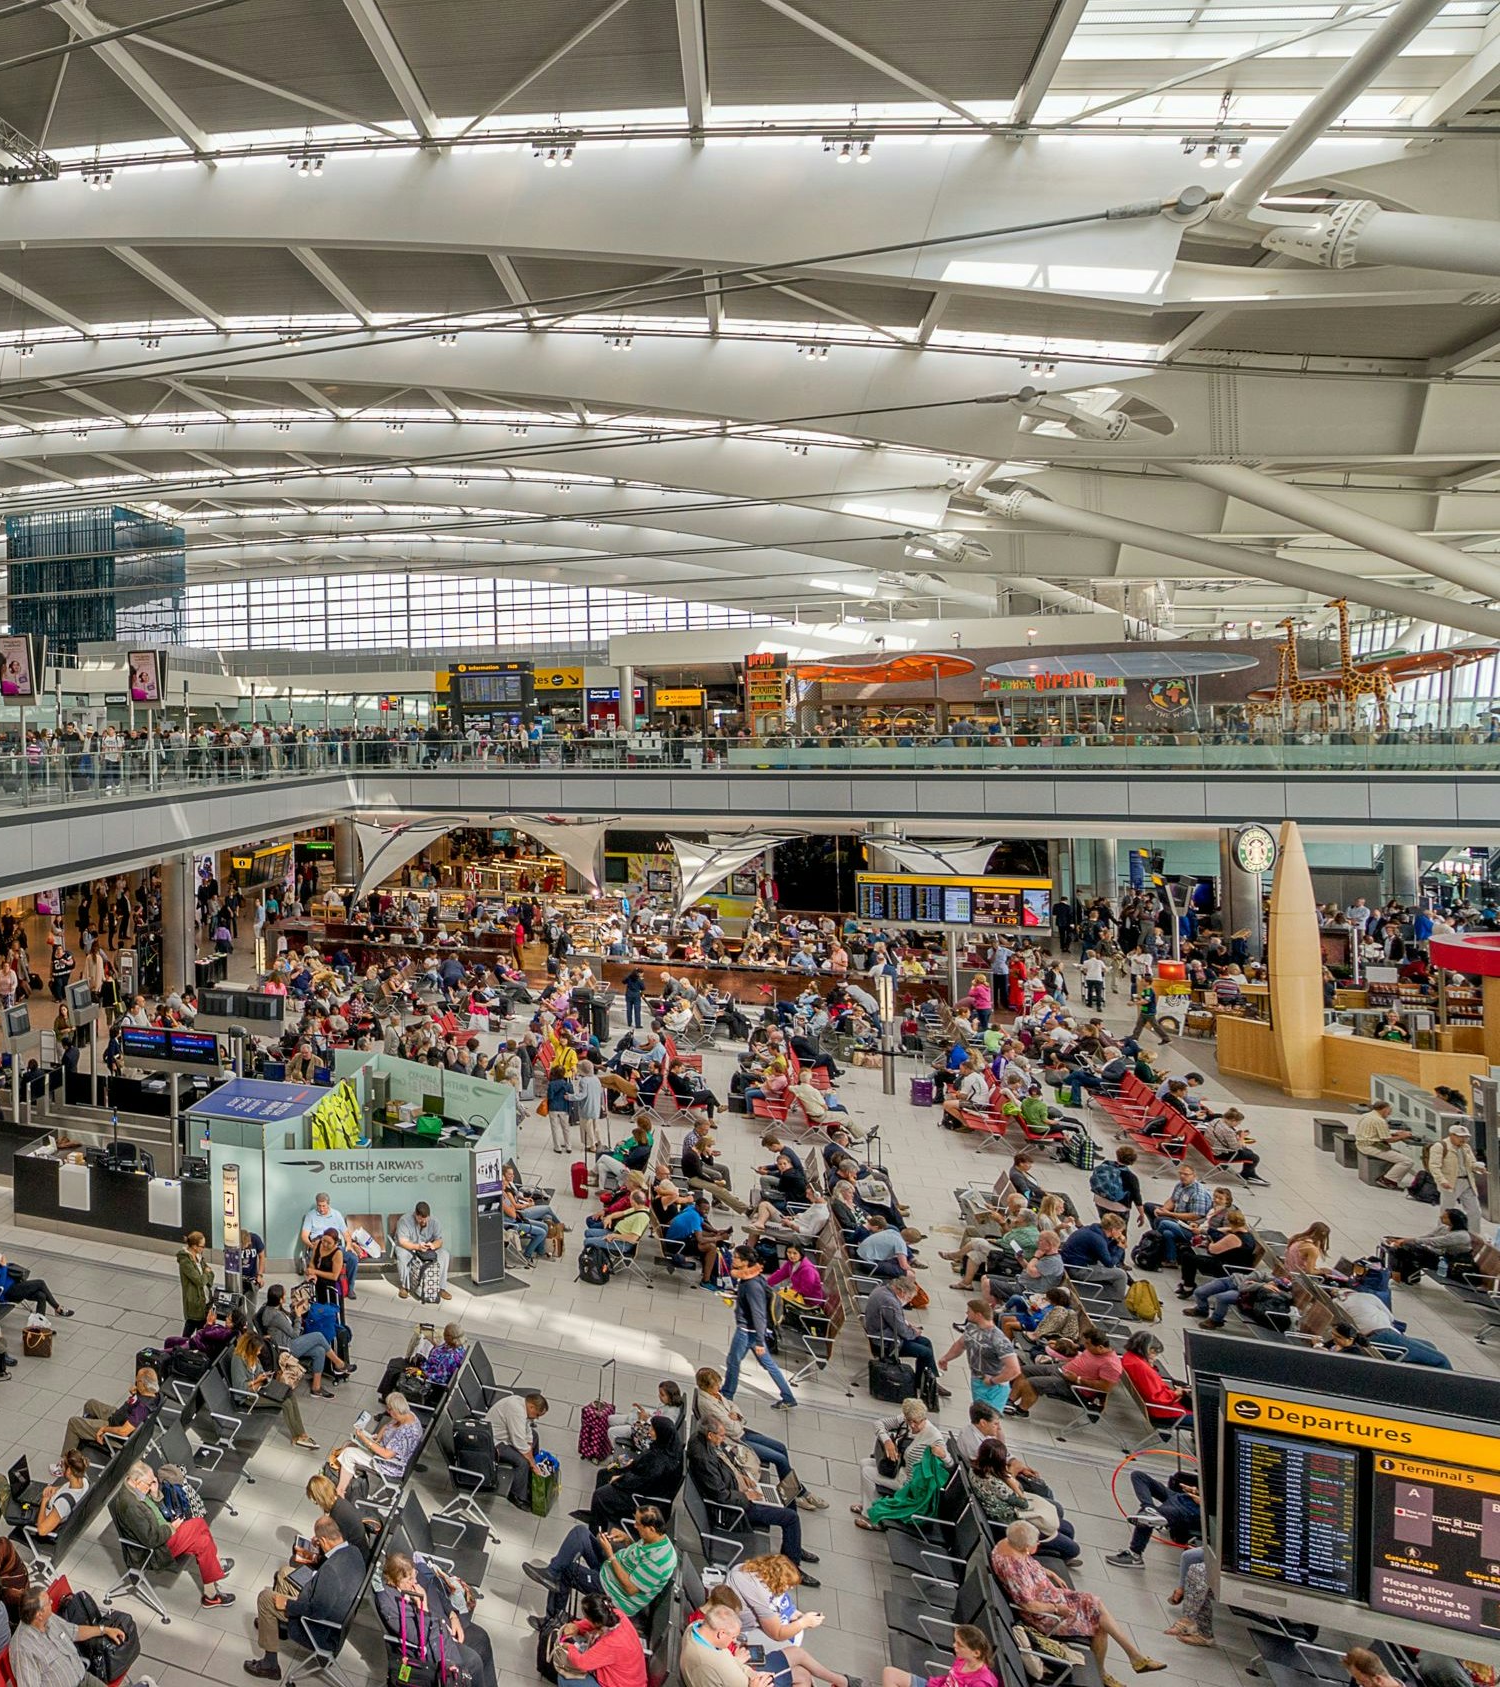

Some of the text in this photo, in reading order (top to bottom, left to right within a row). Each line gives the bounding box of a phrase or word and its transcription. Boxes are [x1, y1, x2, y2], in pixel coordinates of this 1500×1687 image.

[1034, 670, 1096, 692] giraffe
[464, 871, 482, 884] PRET
[996, 917, 1018, 925] 11:29
[330, 1160, 424, 1171] BRITISH AIRWAYS
[330, 1173, 377, 1184] Customer
[378, 1174, 419, 1184] Services
[428, 1172, 462, 1183] Central
[241, 1248, 258, 1259] YPD
[1268, 1406, 1412, 1444] Departures
[1400, 1462, 1475, 1484] Terminal 5
[1408, 1488, 1421, 1498] A
[1492, 1504, 1500, 1513] B
[1451, 1527, 1477, 1538] transit
[1384, 1554, 1440, 1571] Gates A1-A23
[1402, 1563, 1434, 1575] minutes
[1465, 1570, 1488, 1582] Gates
[1472, 1578, 1483, 1586] 15
[1383, 1576, 1454, 1599] Please allow
[1382, 1587, 1470, 1612] enough time to
[1382, 1594, 1472, 1621] reach your gate
